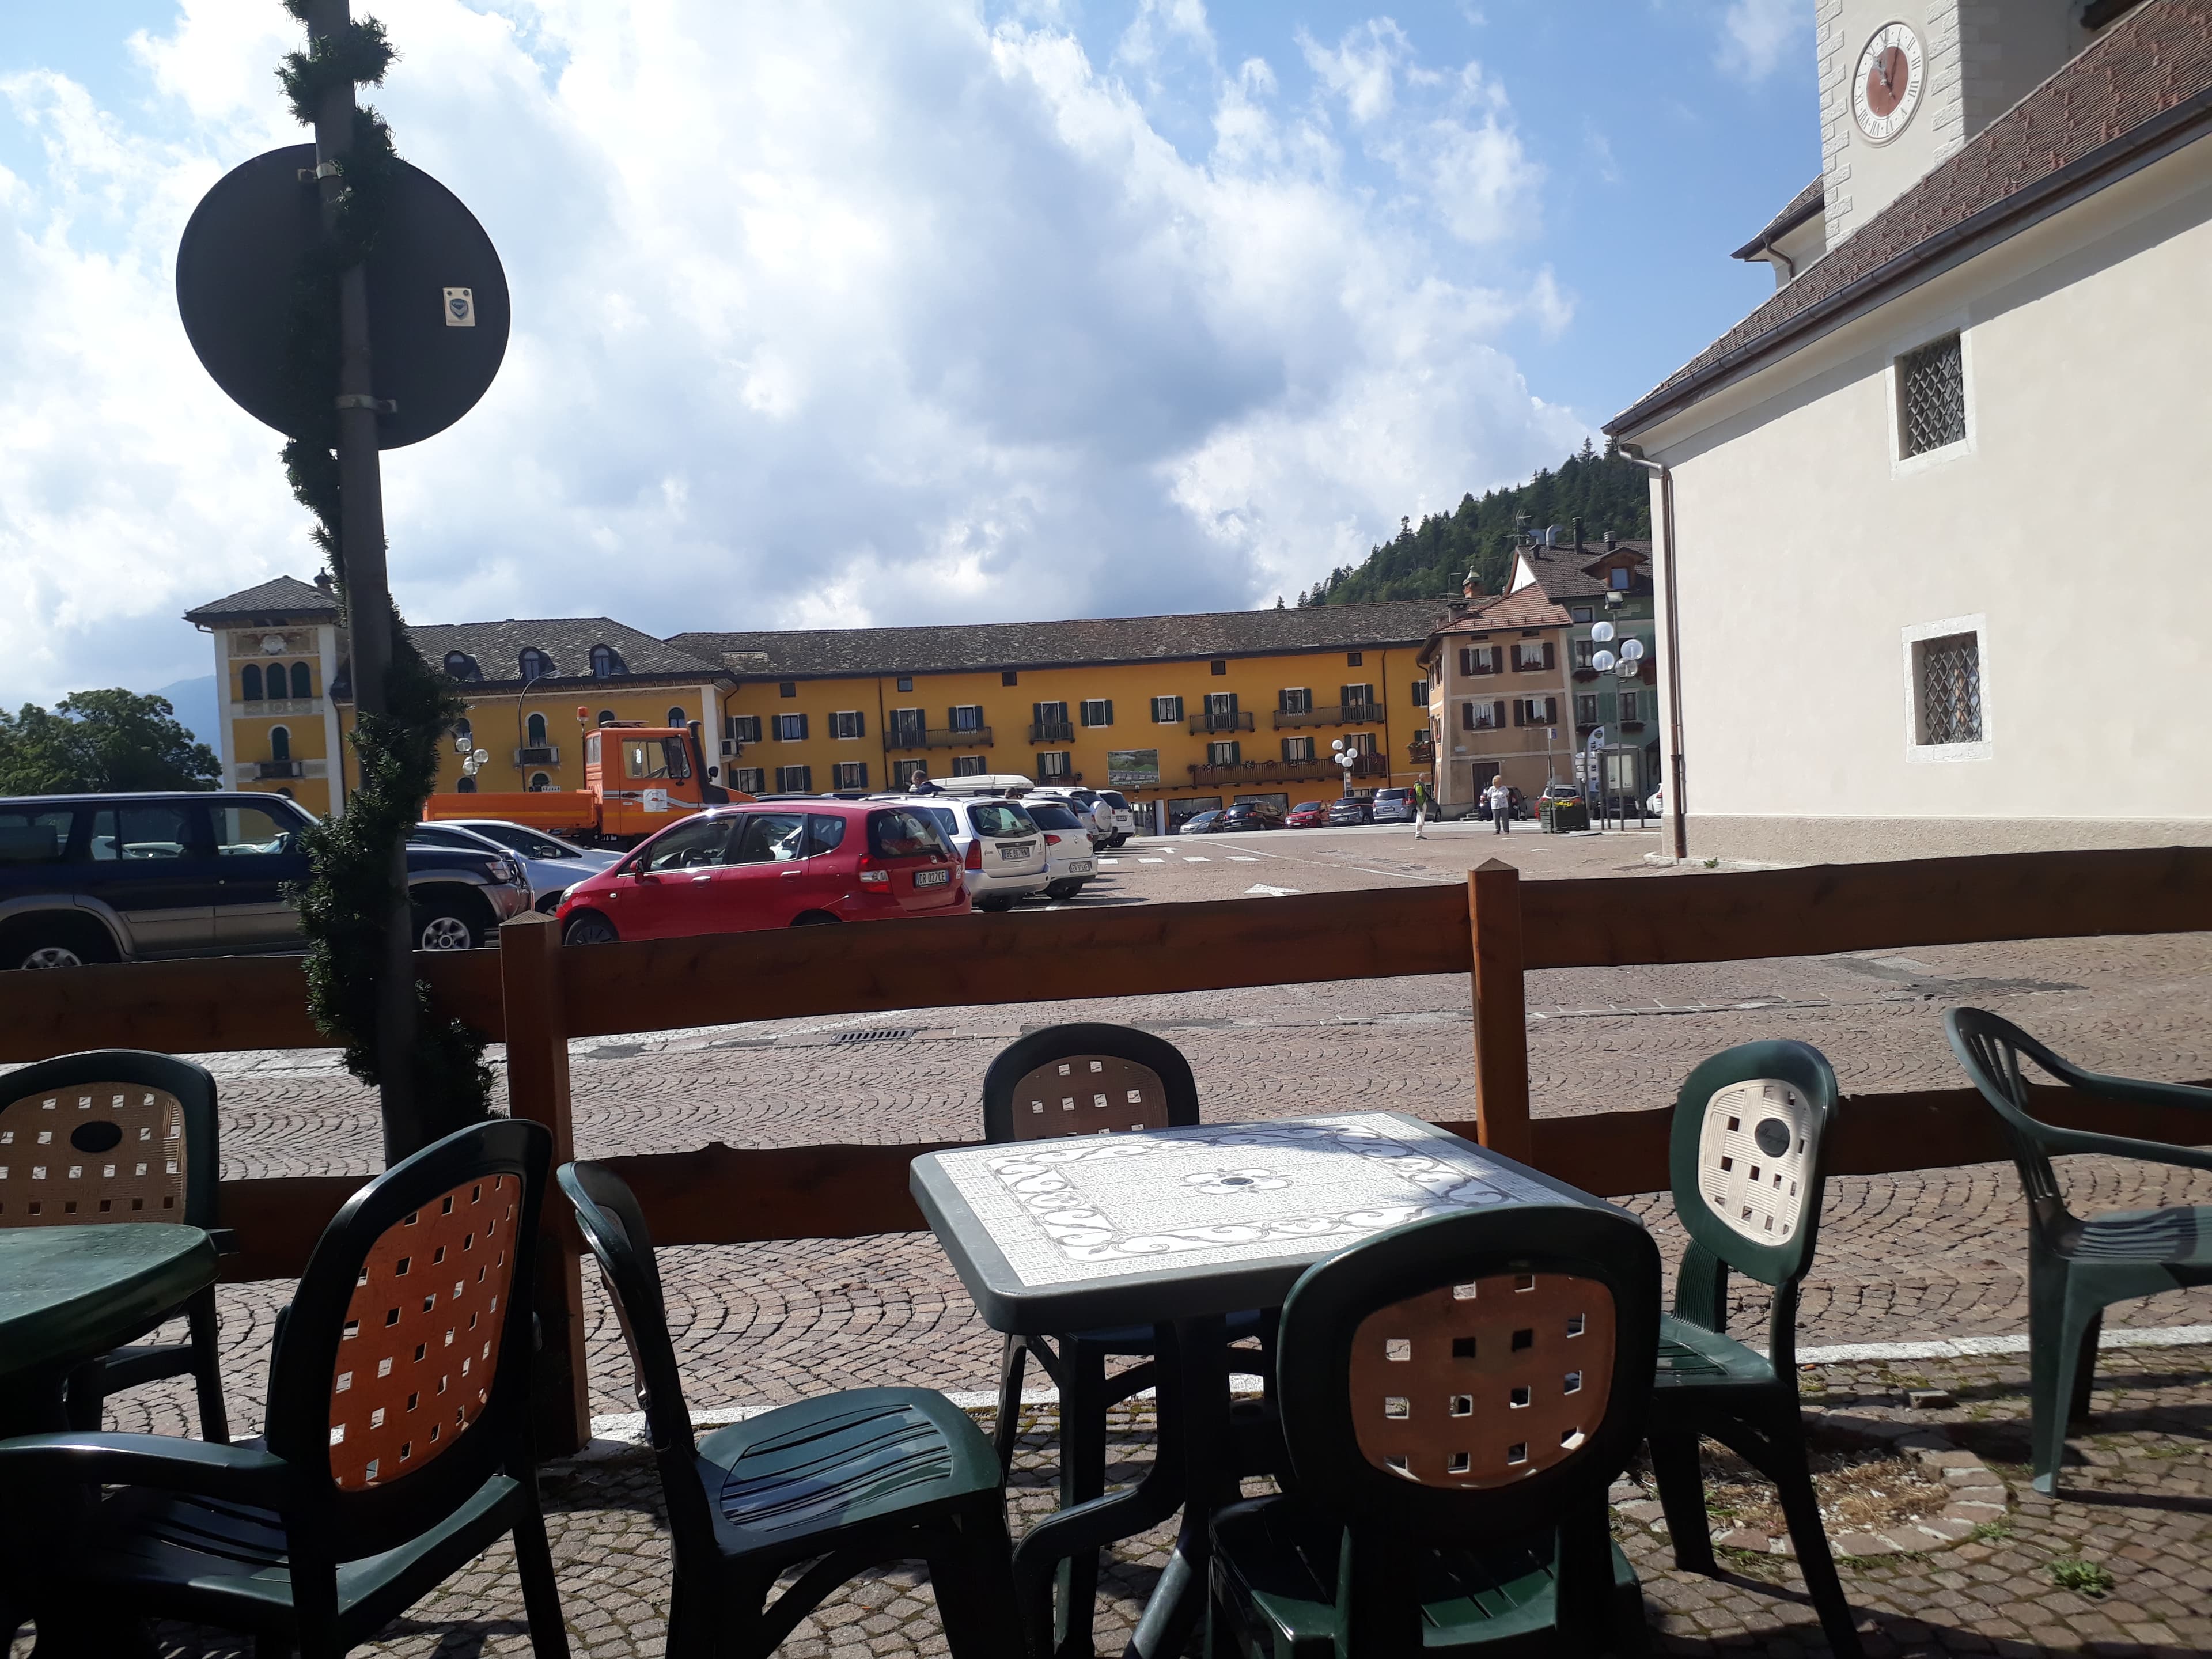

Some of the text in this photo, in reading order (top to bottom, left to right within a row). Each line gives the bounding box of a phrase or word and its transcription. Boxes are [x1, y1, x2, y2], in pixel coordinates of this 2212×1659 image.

[1911, 56, 1921, 70] III
[919, 873, 927, 884] DR
[928, 871, 945, 882] 027CE
